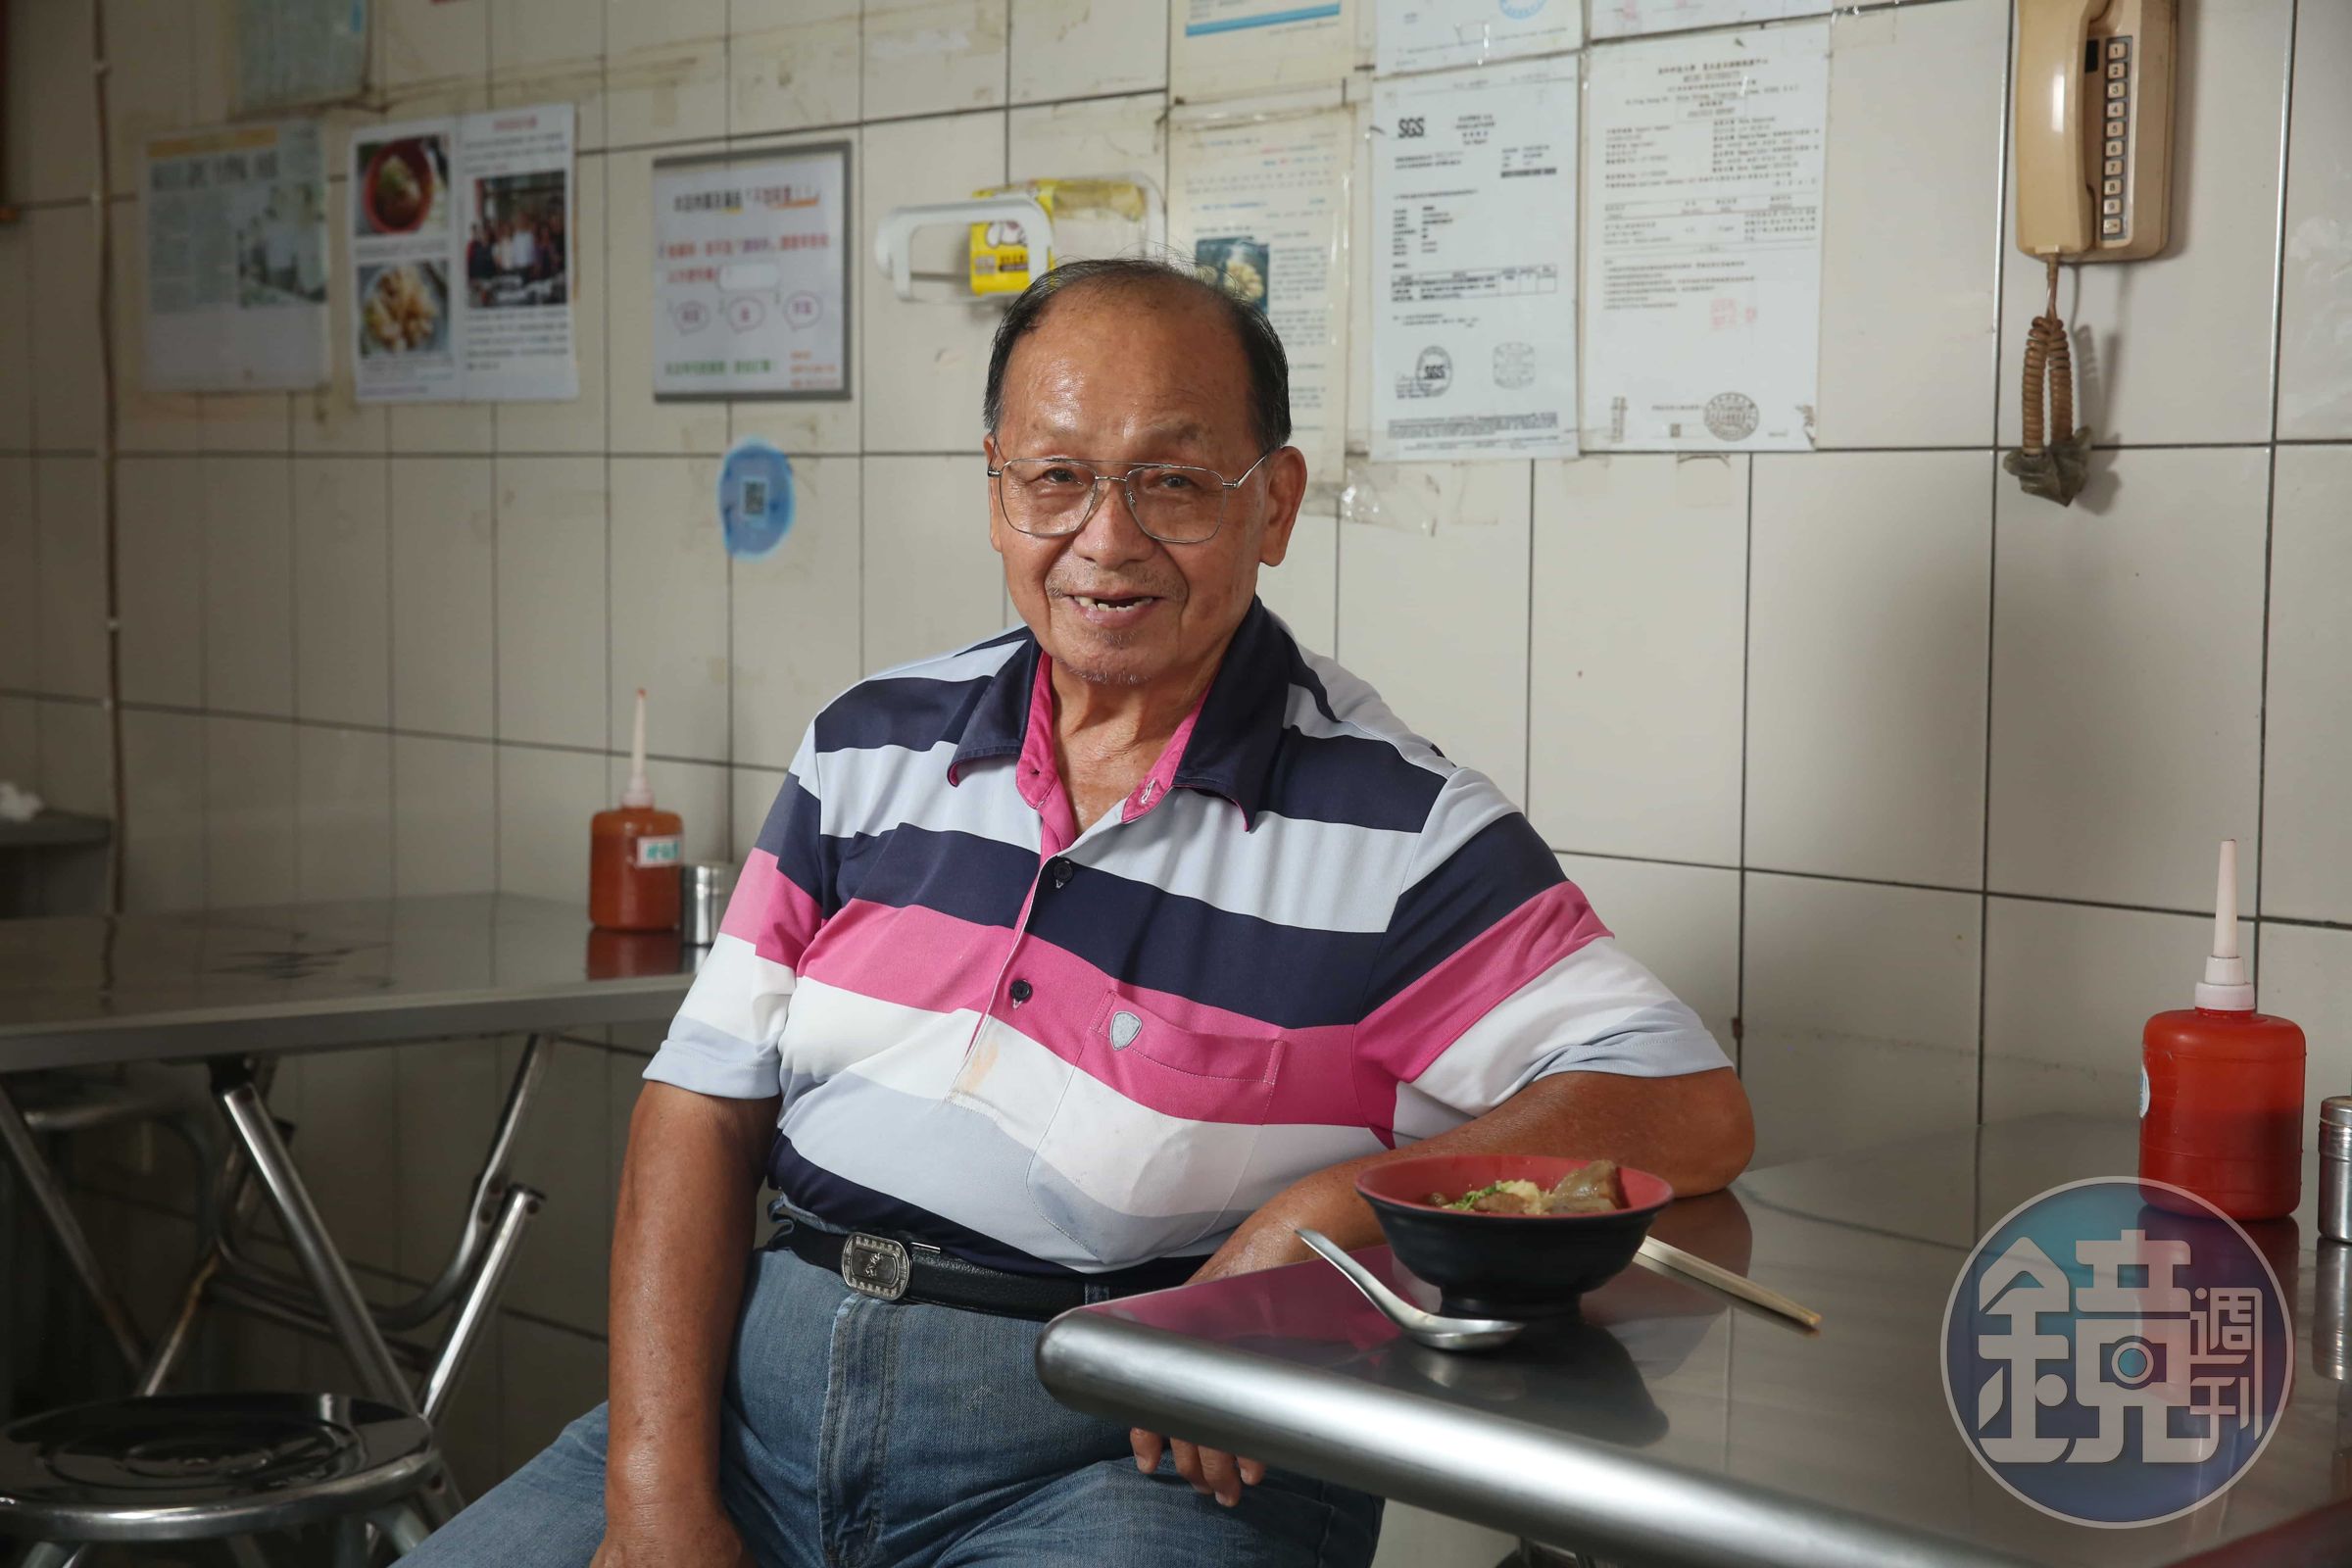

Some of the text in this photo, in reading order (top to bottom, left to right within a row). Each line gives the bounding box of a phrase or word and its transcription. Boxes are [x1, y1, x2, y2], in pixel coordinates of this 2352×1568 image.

[1397, 117, 1425, 138] SGS
[2110, 143, 2117, 153] 6
[2109, 182, 2116, 192] 8
[1424, 365, 1446, 379] SGS
